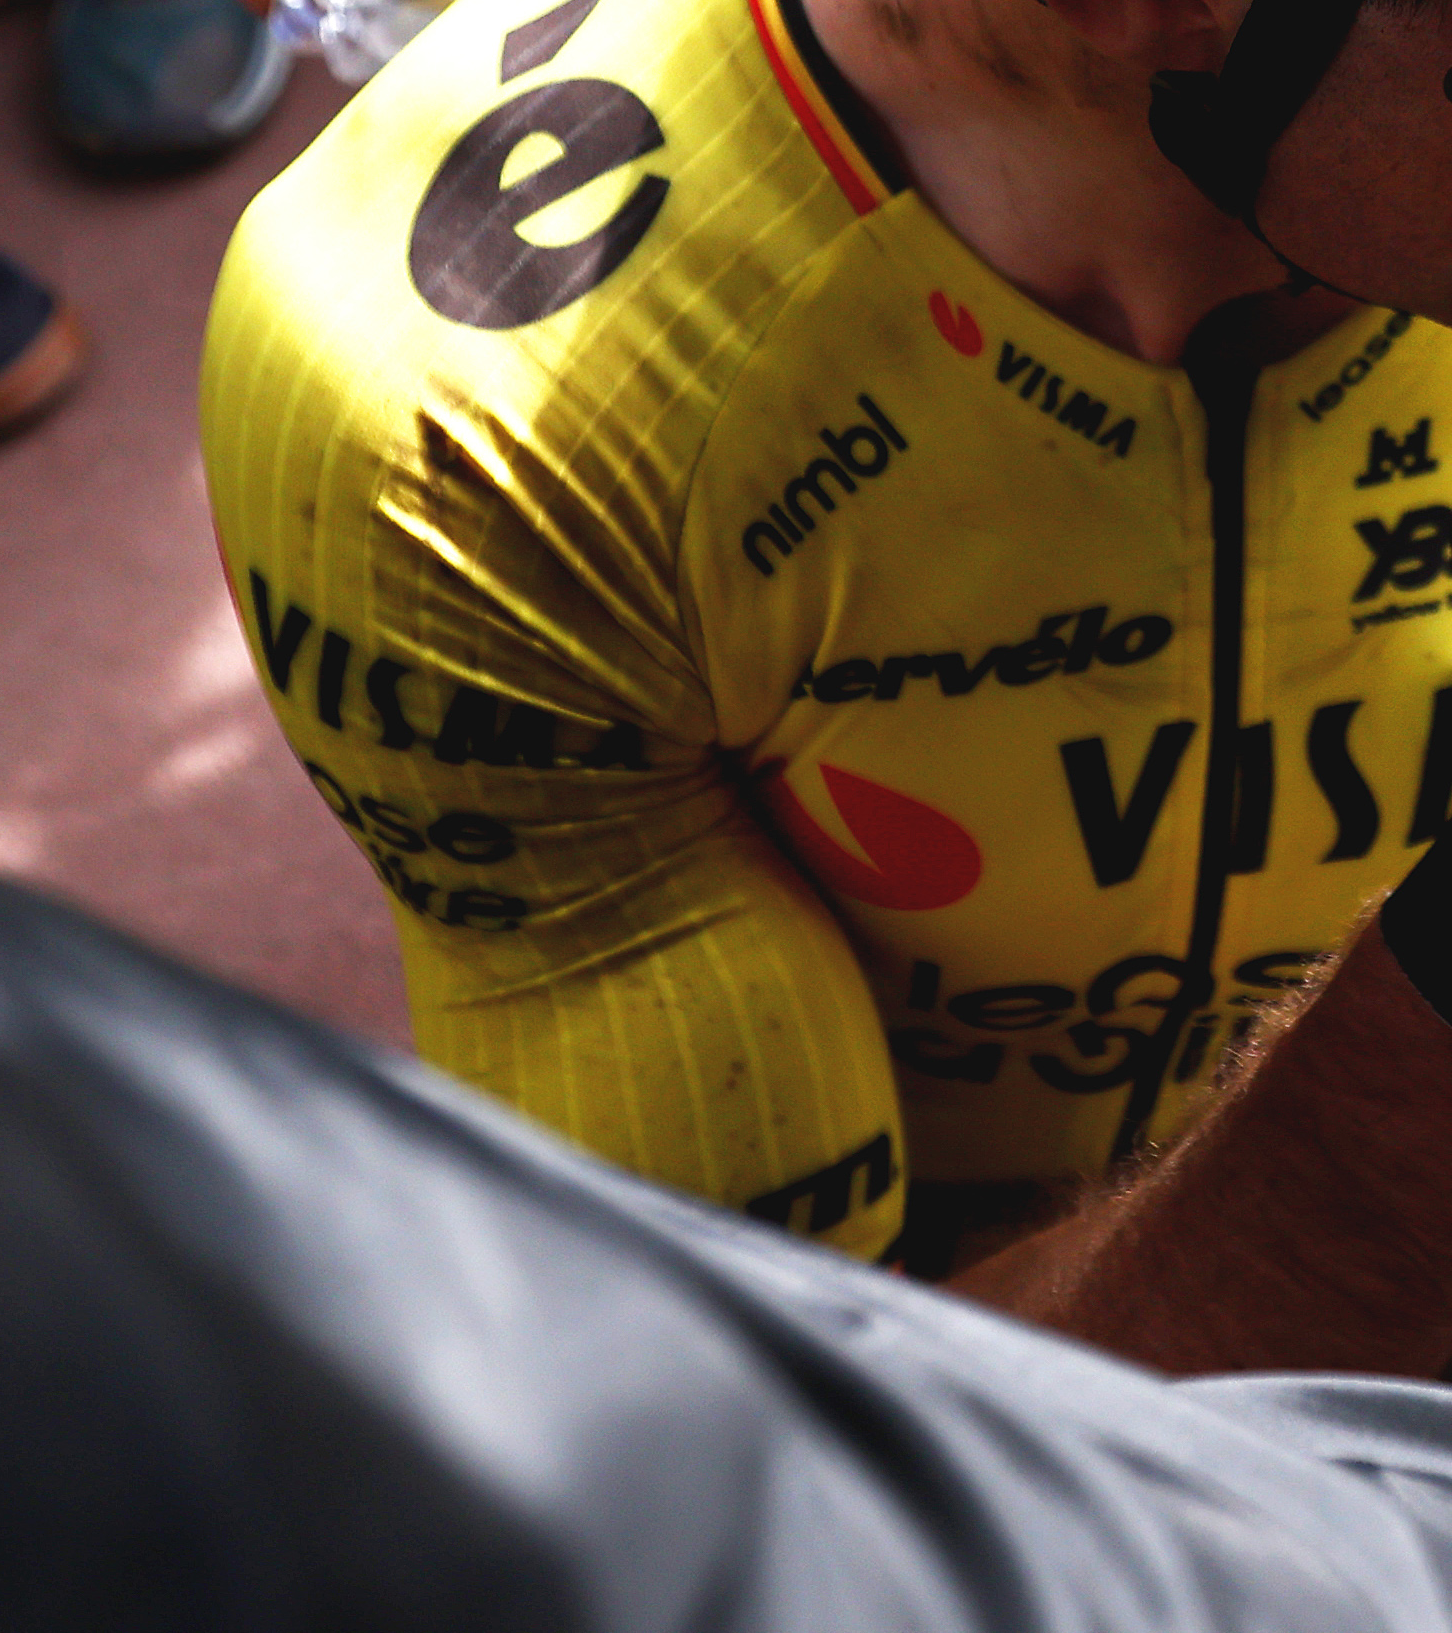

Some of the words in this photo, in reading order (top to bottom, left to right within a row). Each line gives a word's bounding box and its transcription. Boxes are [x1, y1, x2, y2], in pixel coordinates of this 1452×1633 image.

[996, 340, 1137, 460] VISMA
[741, 392, 908, 578] nimbl
[791, 605, 1174, 704] ervélo
